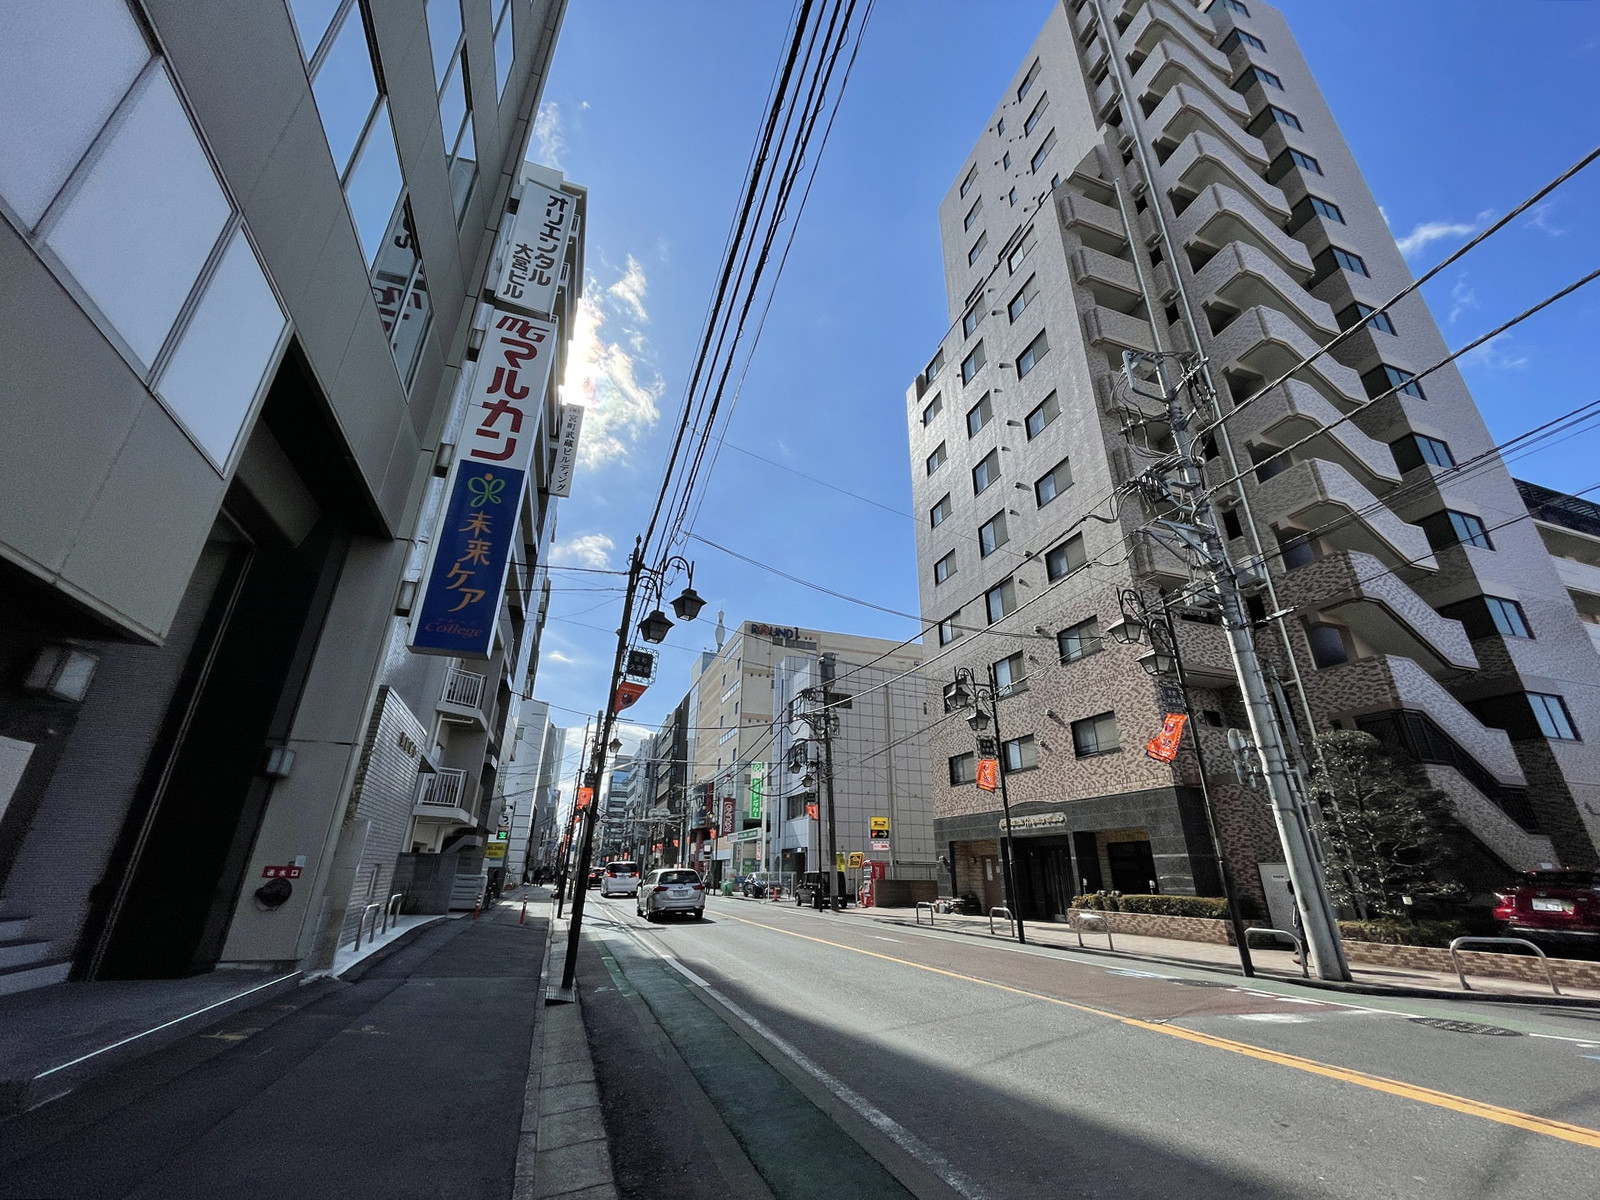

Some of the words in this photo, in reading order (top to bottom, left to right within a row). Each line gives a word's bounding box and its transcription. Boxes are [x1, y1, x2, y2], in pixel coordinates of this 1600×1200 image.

[503, 243, 533, 300] 大宮ビル
[527, 195, 568, 287] オリエンタル
[470, 337, 538, 461] マルカン
[446, 511, 493, 612] 未来ケア
